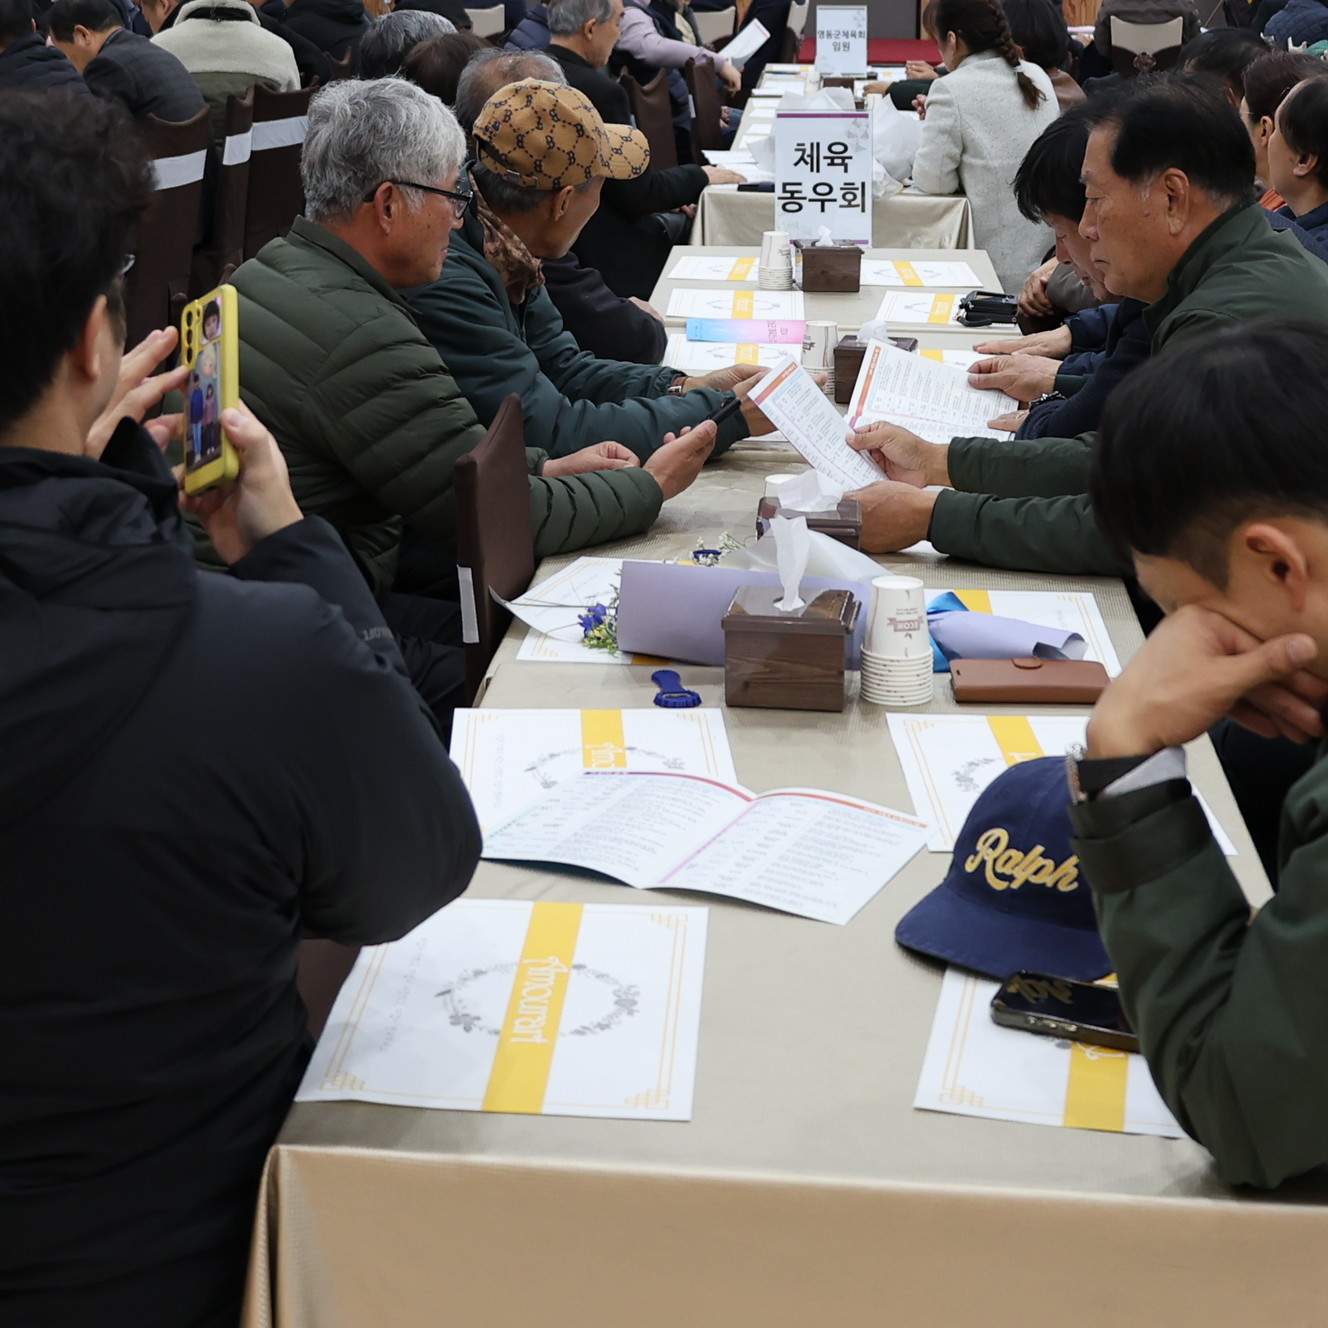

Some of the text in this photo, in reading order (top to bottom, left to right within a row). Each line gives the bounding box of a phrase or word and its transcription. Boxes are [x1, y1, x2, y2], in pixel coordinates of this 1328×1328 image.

[817, 29, 865, 39] 영동군체육회
[832, 41, 850, 52] 임원
[793, 142, 853, 173] 체육
[777, 181, 866, 213] 동우회
[965, 828, 1080, 892] Ralph
[509, 955, 570, 1044] Amourart
